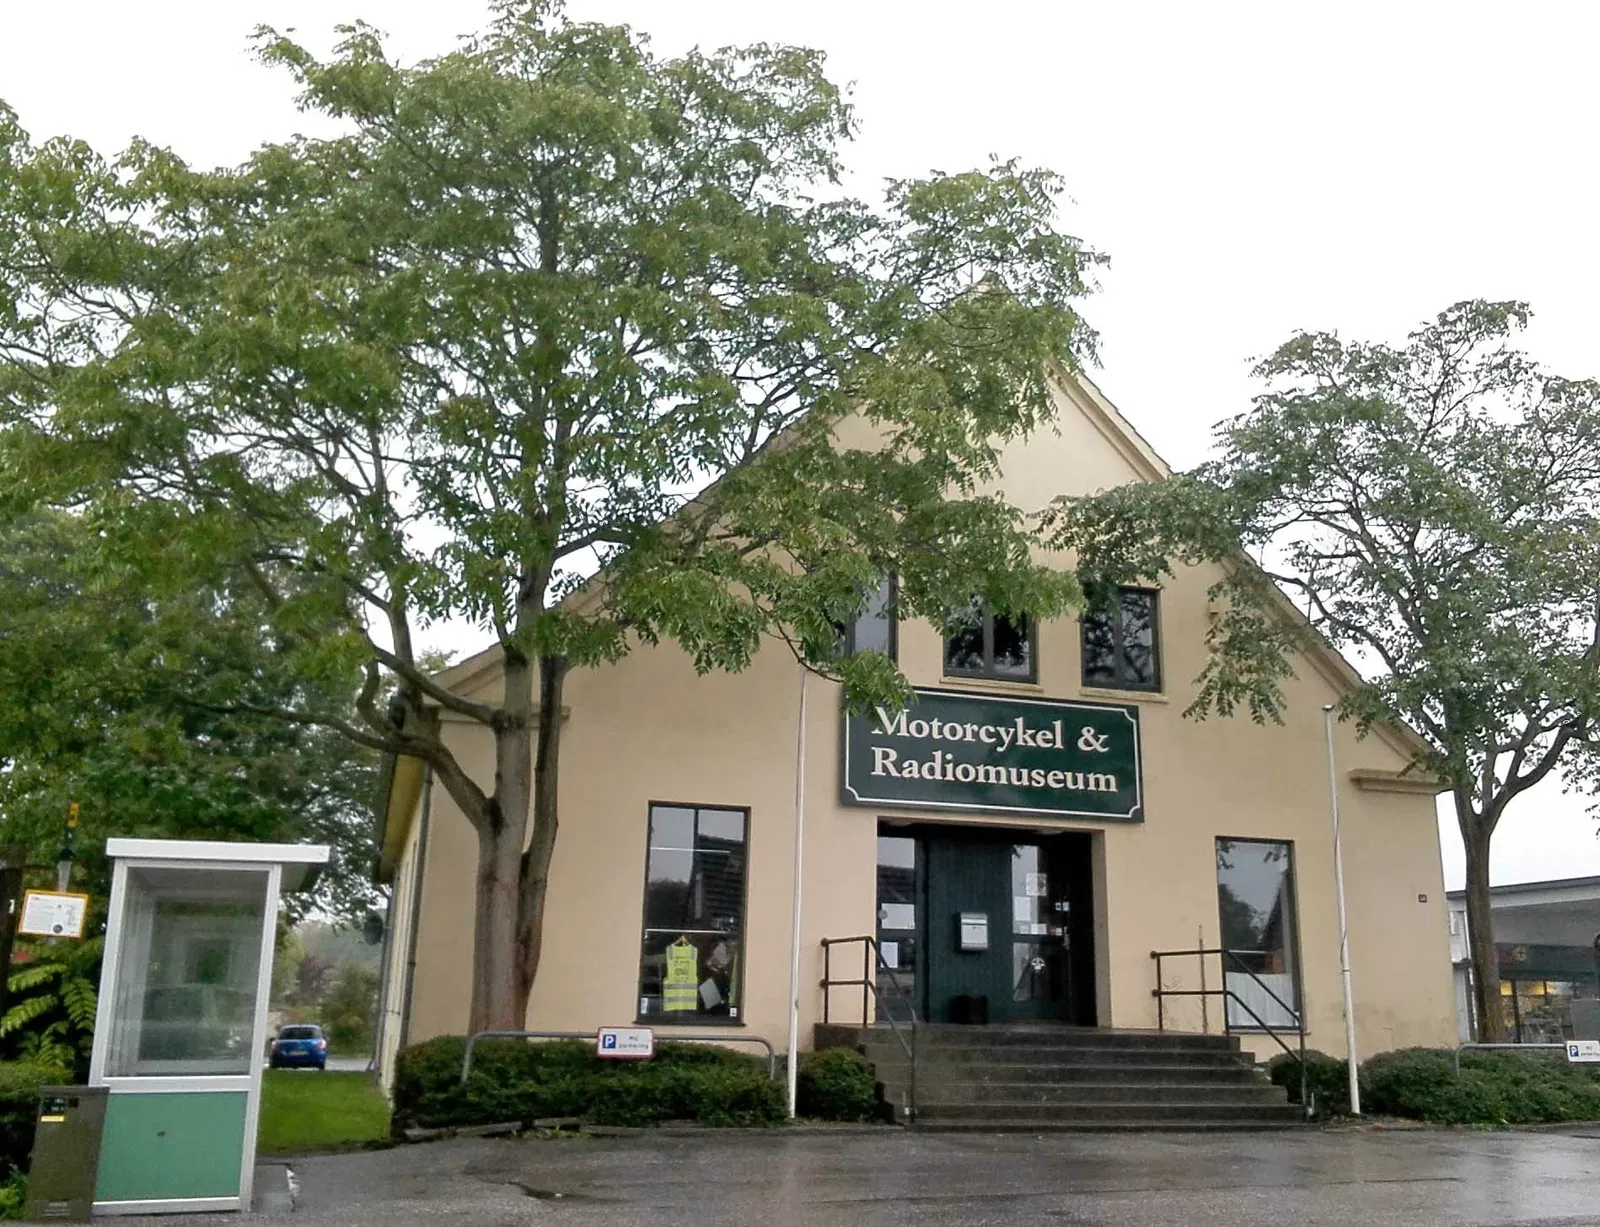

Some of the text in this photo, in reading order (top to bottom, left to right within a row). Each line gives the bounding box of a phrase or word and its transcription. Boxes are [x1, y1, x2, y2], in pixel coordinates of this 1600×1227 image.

[871, 707, 1109, 752] Motorcykel &
[871, 747, 1118, 792] Radiomuseum
[605, 1035, 614, 1048] P
[1570, 1046, 1578, 1056] P
